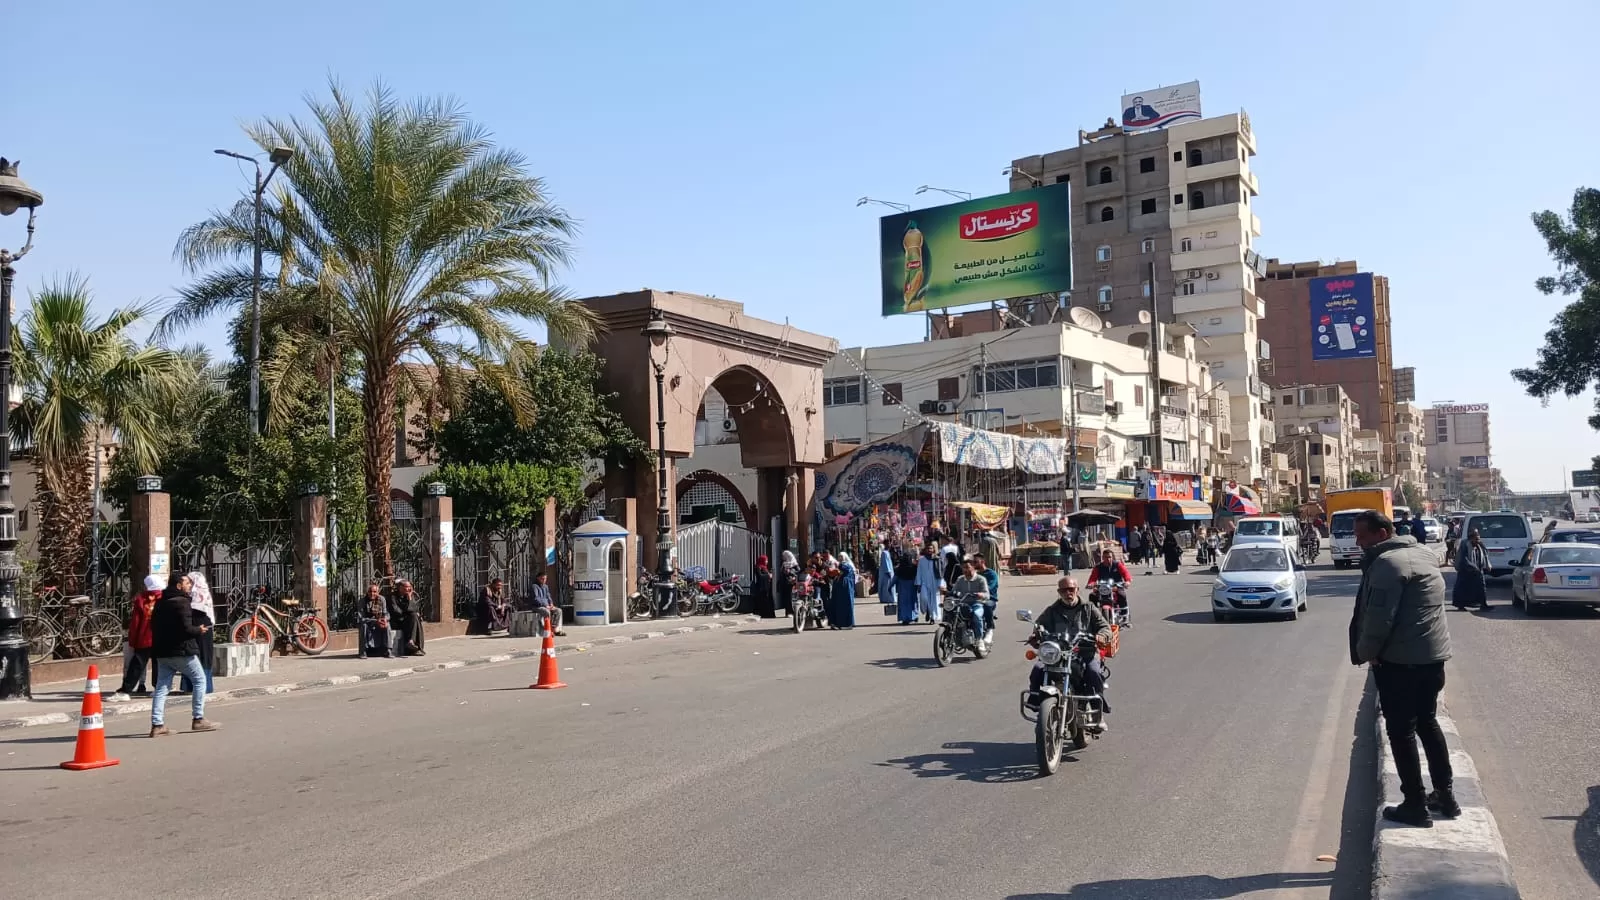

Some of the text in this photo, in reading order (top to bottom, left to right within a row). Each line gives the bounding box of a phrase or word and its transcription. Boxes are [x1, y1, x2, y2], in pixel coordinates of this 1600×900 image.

[964, 208, 1033, 236] كريستال
[954, 260, 984, 269] الطبيعة
[987, 258, 998, 266] من
[982, 271, 998, 279] مش
[1000, 265, 1027, 277] الشكل
[1441, 402, 1488, 413] TORNADO
[579, 582, 603, 590] TRAFFIC
